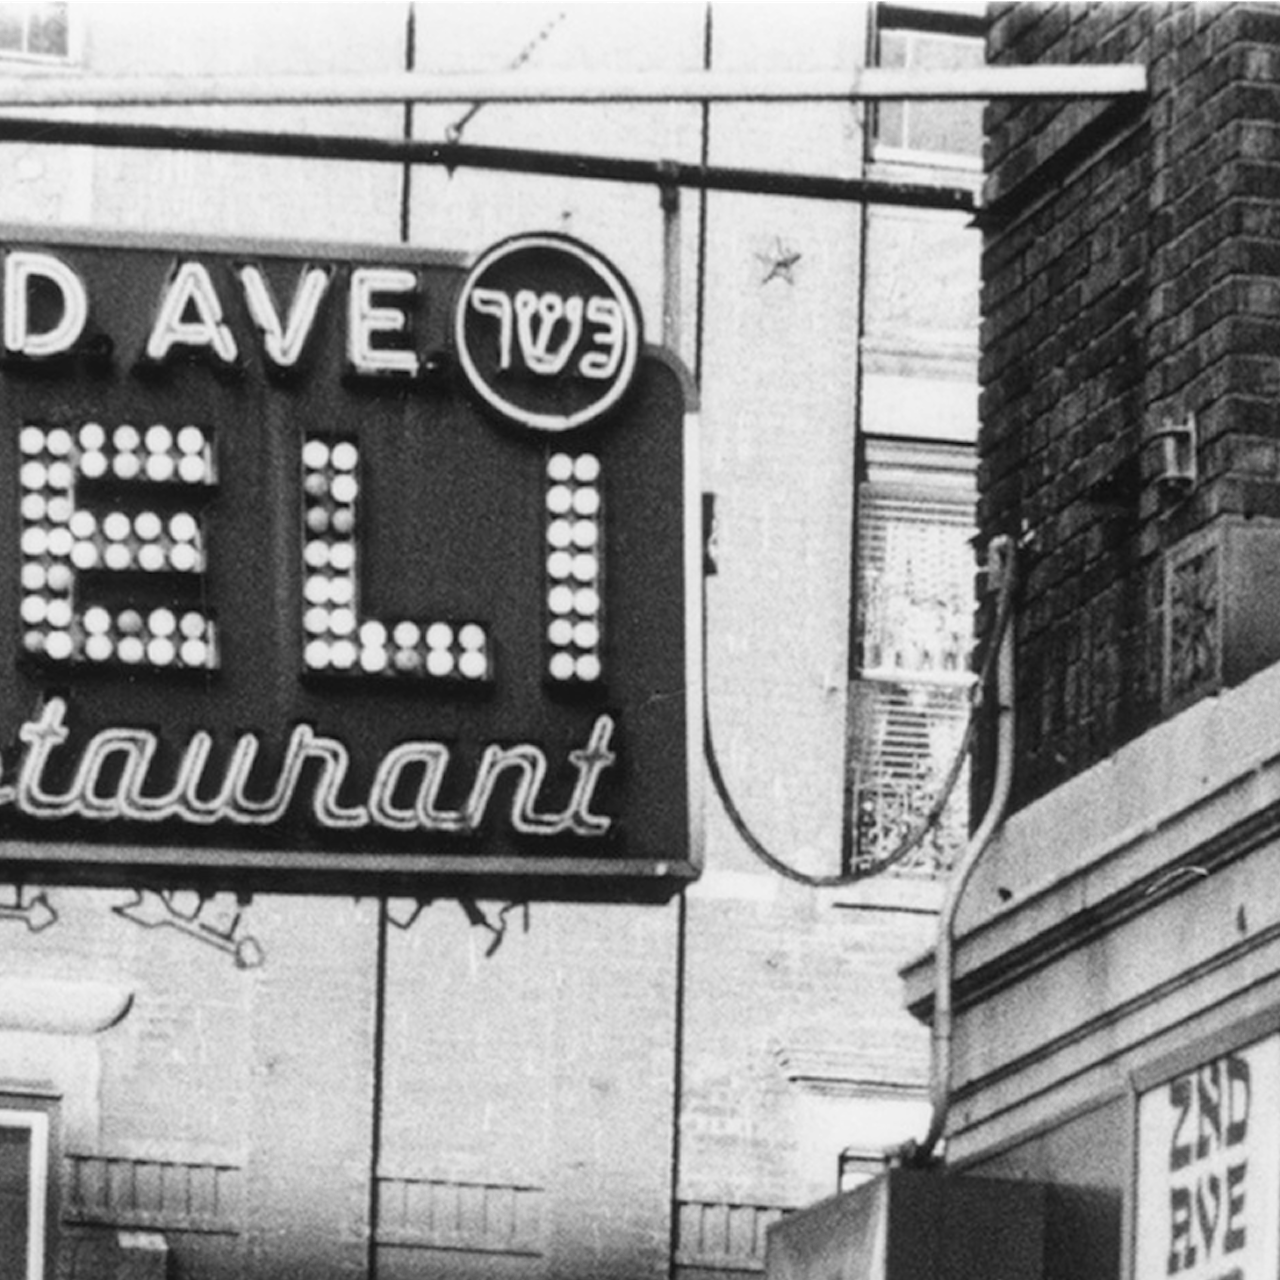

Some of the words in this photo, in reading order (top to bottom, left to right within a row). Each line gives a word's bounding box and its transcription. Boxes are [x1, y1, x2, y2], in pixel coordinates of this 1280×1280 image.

[148, 262, 418, 374] AVE
[1170, 1055, 1251, 1173] 2ND
[1167, 1163, 1248, 1276] AVE
